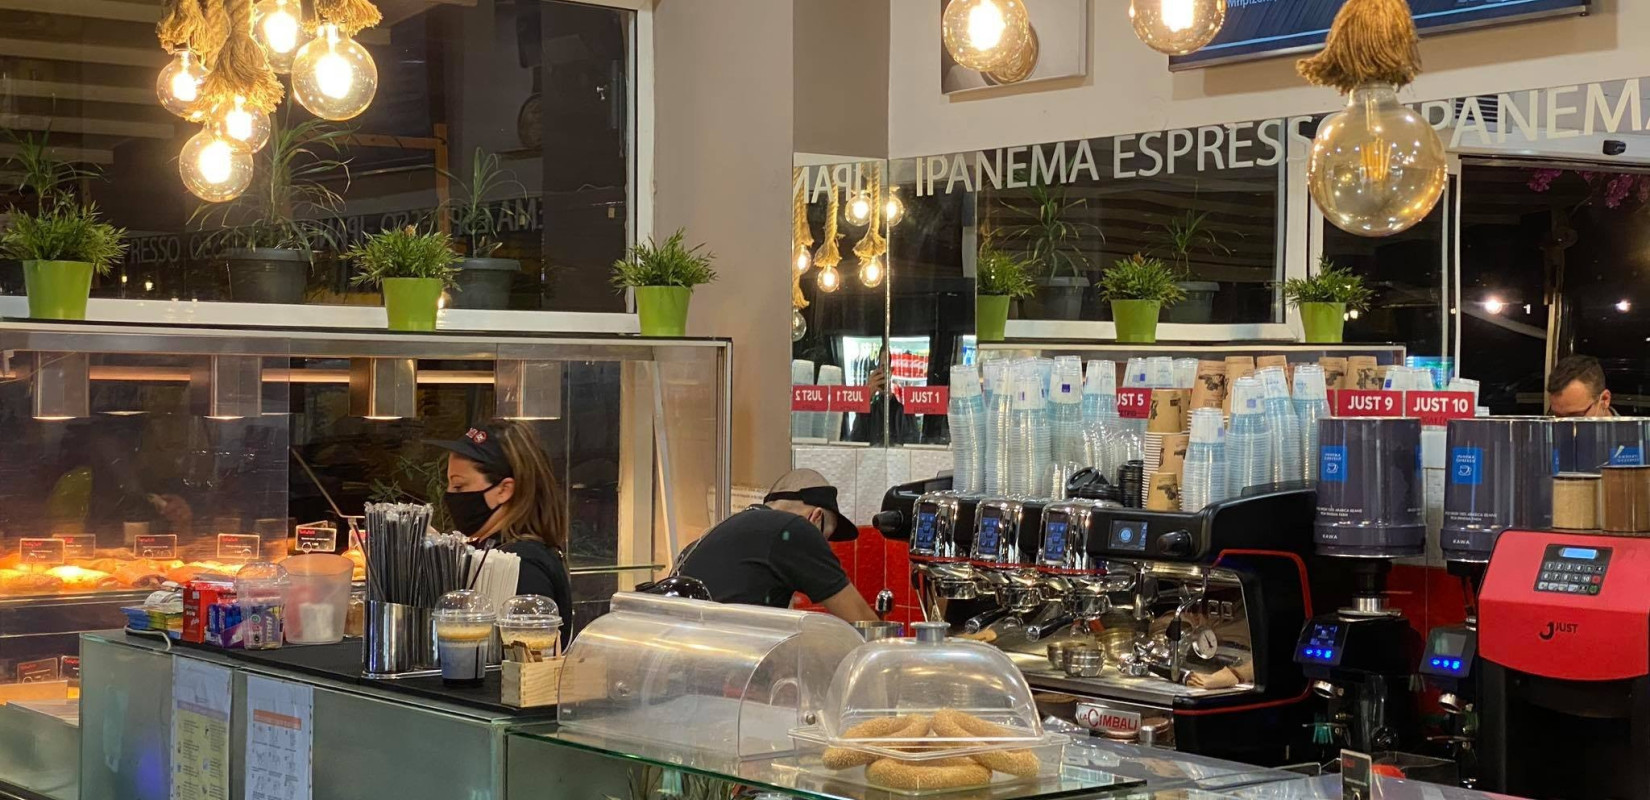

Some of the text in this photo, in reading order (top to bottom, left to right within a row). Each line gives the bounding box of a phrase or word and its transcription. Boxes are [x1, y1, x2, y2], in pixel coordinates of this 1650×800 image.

[1406, 78, 1650, 149] PANEM
[916, 112, 1338, 197] IPANEMA ESPRESS
[910, 391, 940, 403] JUST 1
[1137, 393, 1144, 406] 5
[1348, 396, 1393, 410] JUST 9
[1413, 397, 1469, 413] JUST 10
[1088, 708, 1138, 731] CIMBALI
